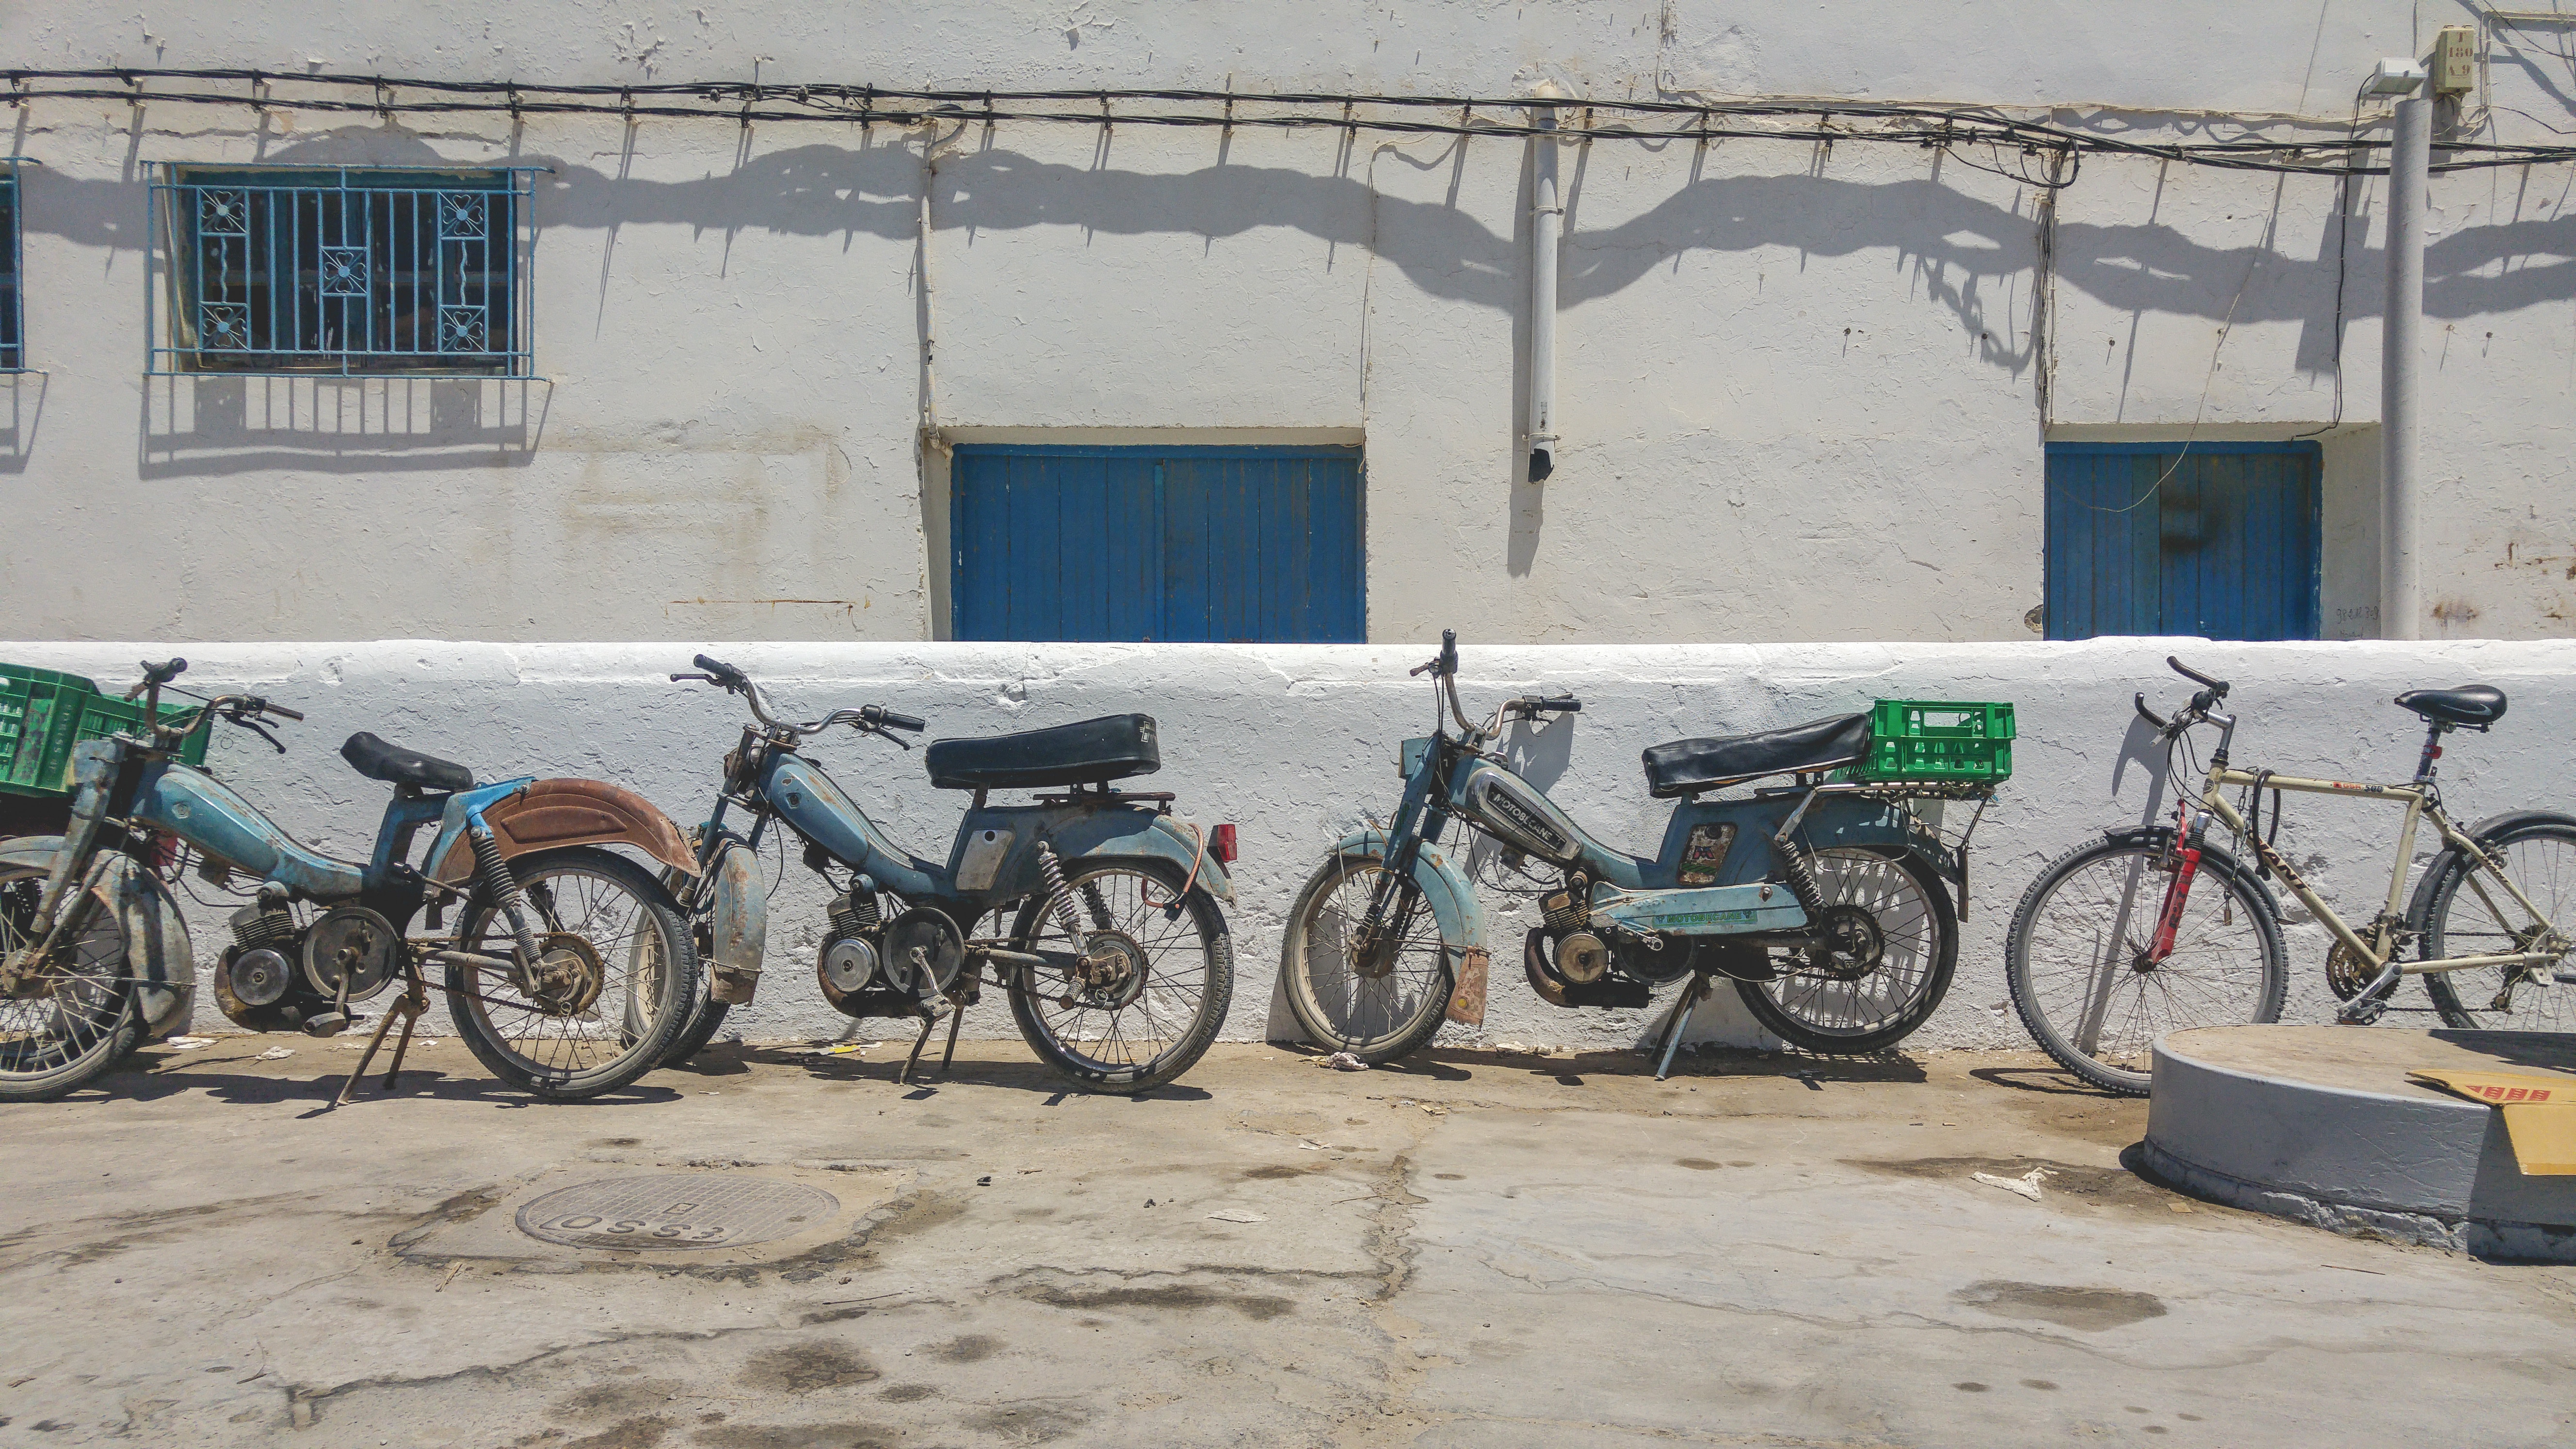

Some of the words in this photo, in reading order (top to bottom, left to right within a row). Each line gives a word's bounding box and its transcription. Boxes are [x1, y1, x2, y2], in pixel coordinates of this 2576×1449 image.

[2364, 784, 2384, 793] 500
[1494, 794, 1552, 841] MOTOBECANE
[1667, 912, 1742, 923] MOTOBECANE
